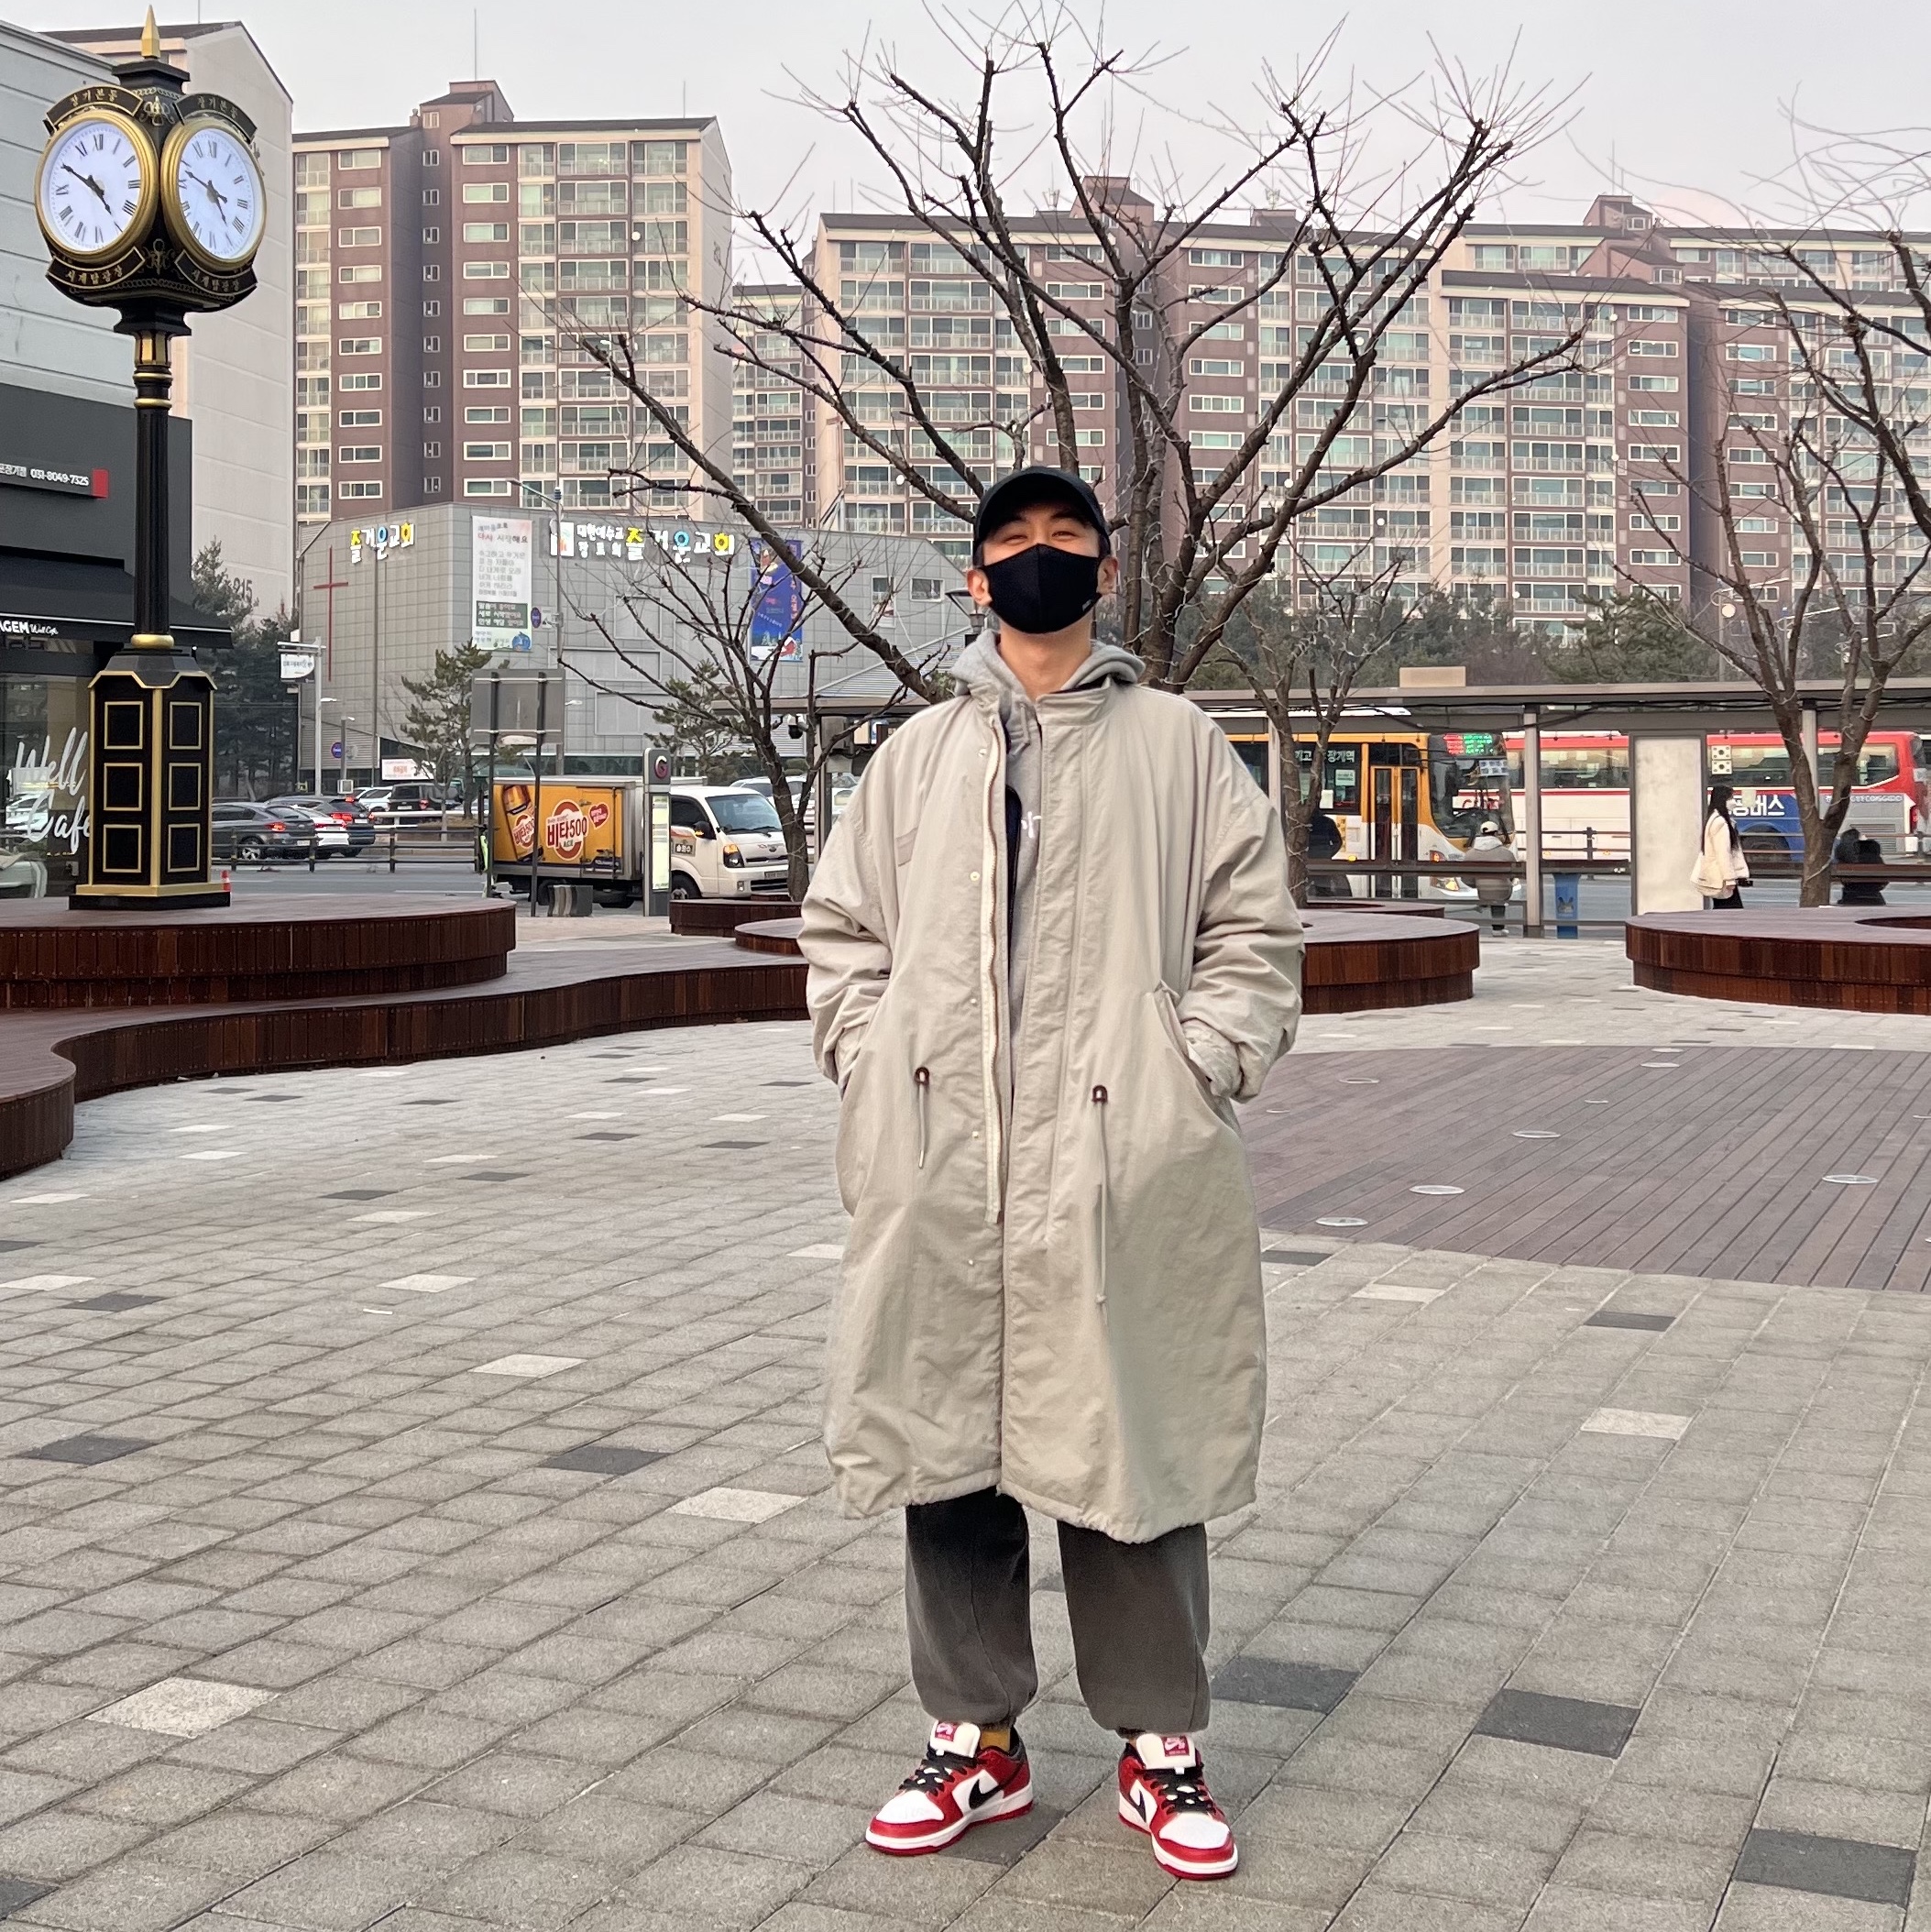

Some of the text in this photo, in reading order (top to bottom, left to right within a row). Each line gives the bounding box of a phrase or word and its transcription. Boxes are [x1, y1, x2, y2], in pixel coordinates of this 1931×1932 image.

[70, 88, 119, 107] 장기본동
[197, 95, 239, 119] 장기본동
[350, 521, 415, 564] 즐거운교회
[625, 526, 735, 564] 즐거운교회
[16, 726, 88, 796] Well
[547, 816, 587, 848] 비타500
